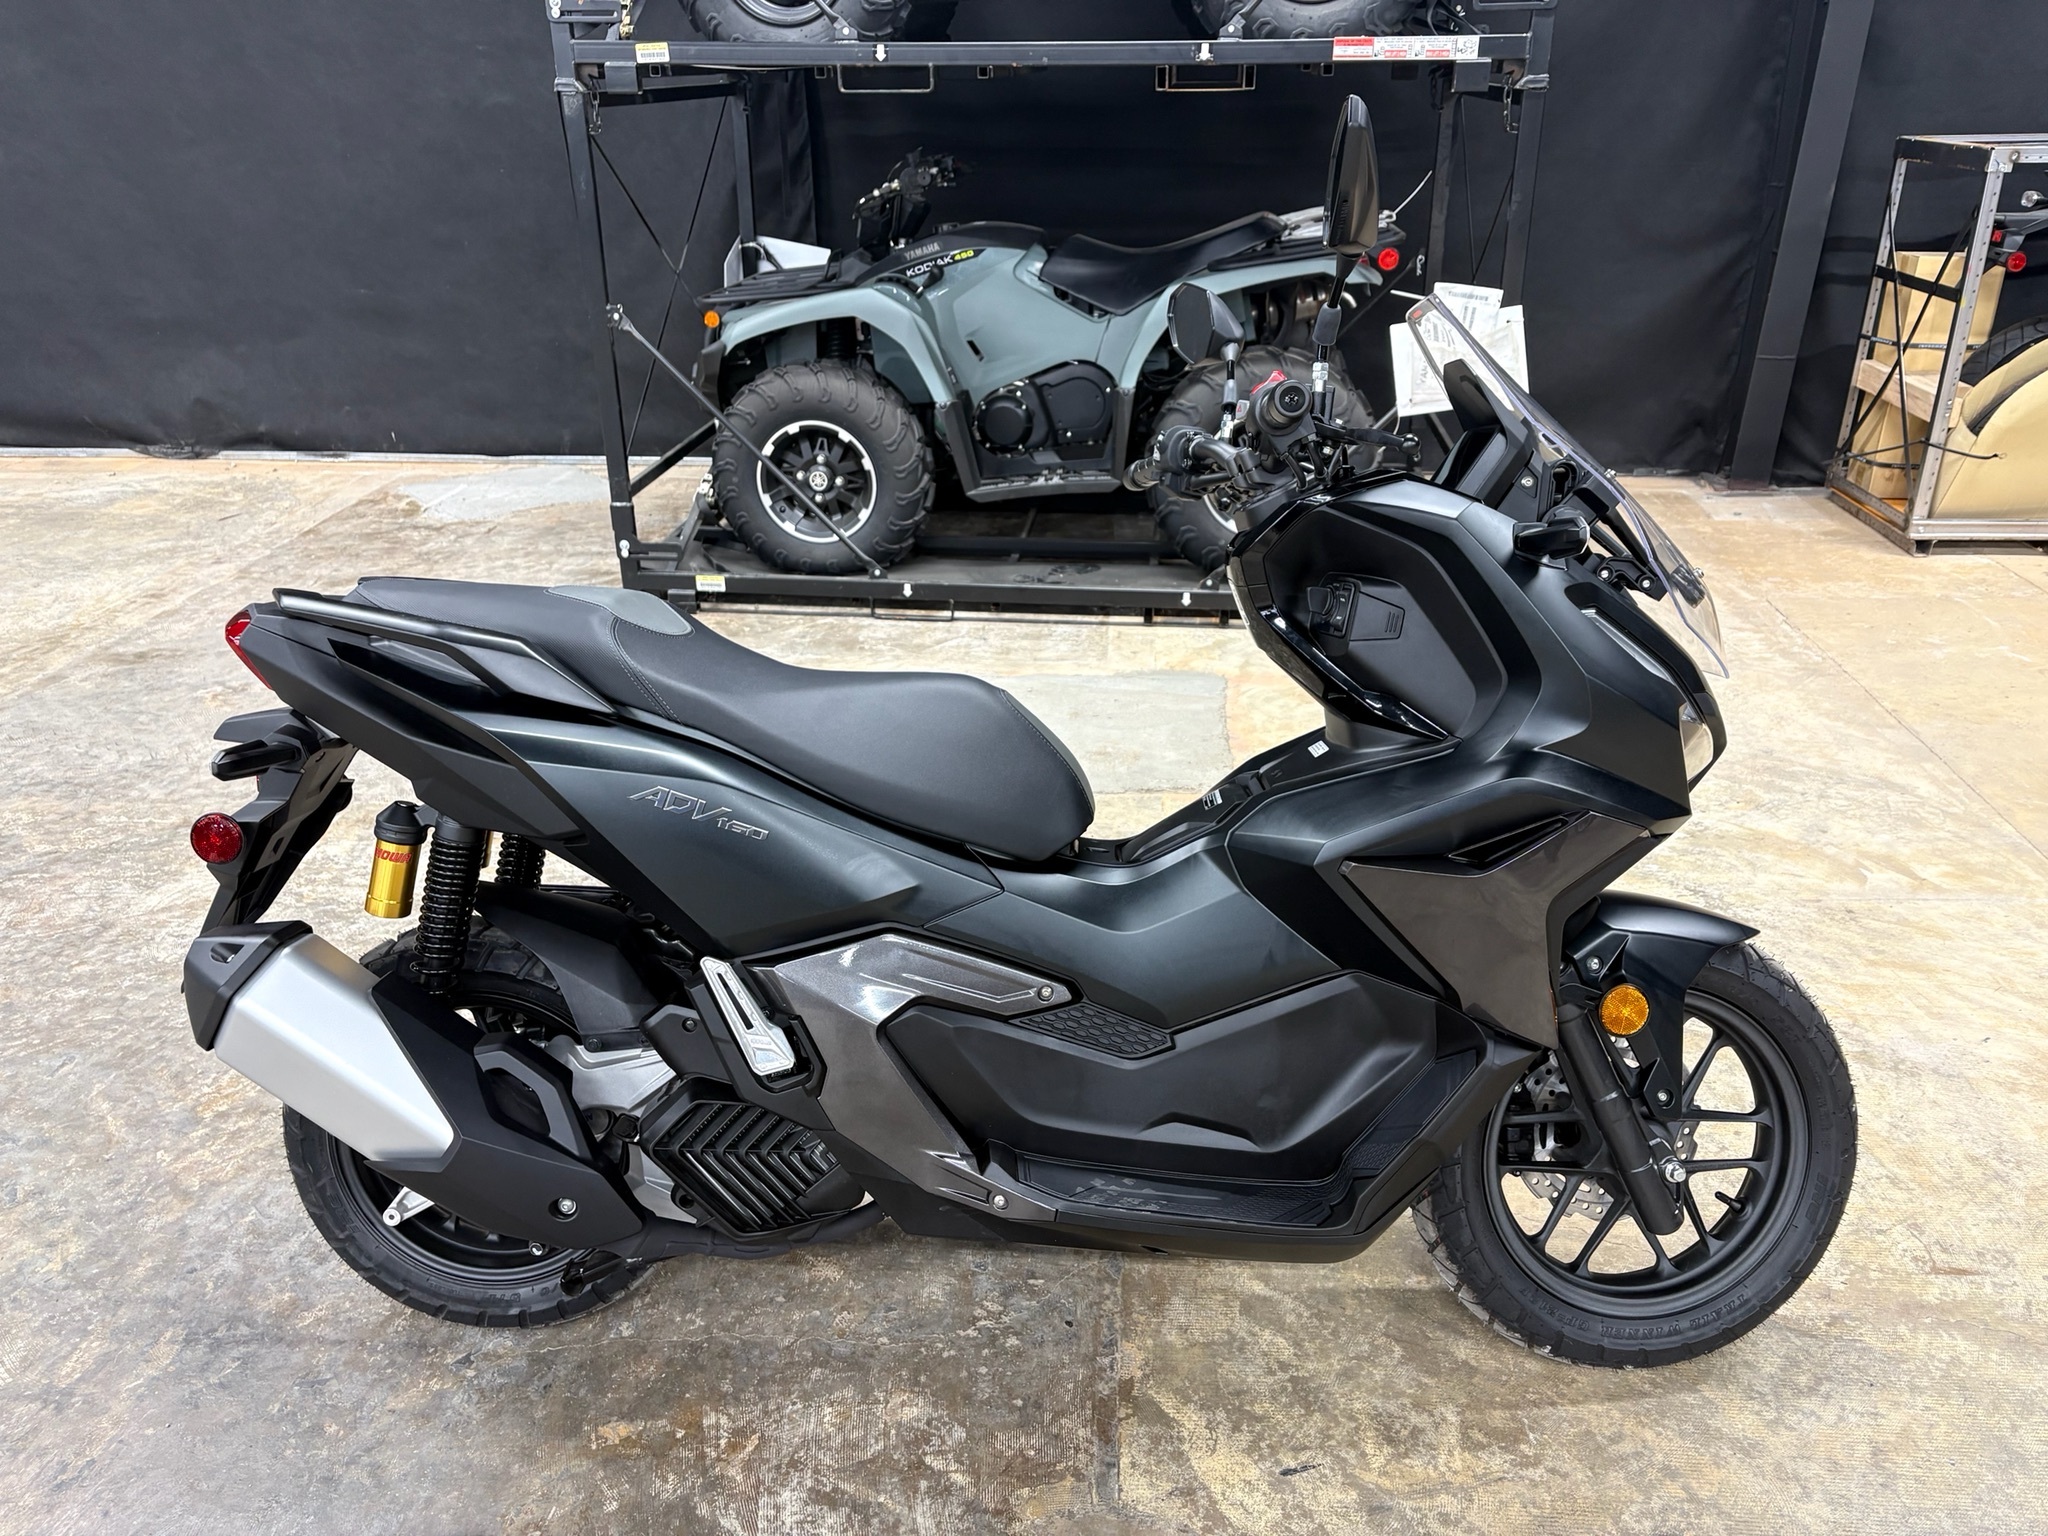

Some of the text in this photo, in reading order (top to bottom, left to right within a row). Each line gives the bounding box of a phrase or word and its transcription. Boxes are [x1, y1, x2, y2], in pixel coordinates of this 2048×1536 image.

[904, 242, 940, 260] YAMAHA
[953, 249, 975, 261] 450
[626, 786, 770, 841] ADV 160
[1689, 1293, 1745, 1330] TRAIL
[1600, 1324, 1682, 1341] WINNER
